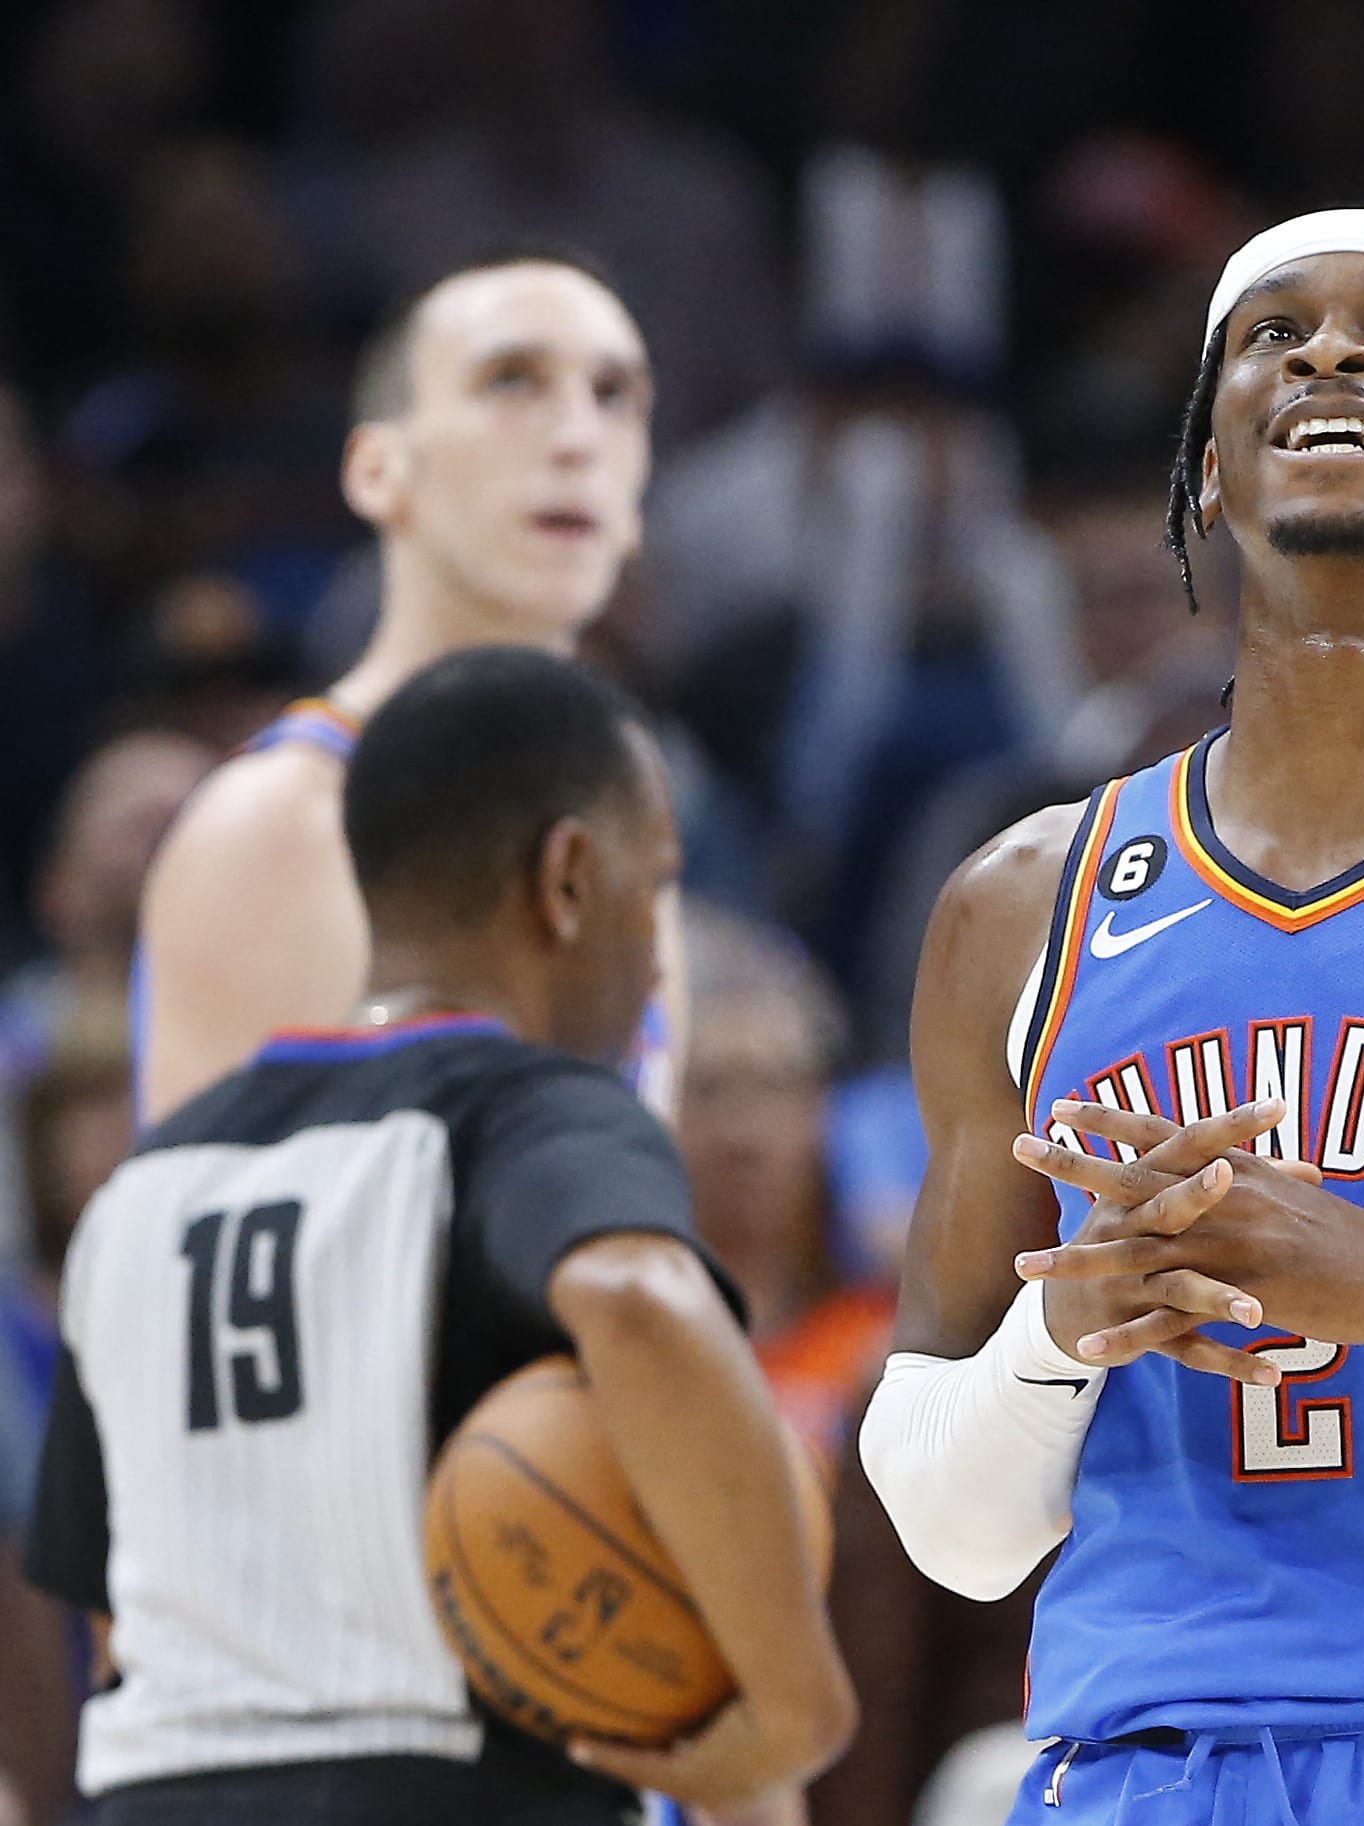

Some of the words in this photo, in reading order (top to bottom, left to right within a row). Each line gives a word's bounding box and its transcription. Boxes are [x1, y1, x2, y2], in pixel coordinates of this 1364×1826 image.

[1109, 841, 1155, 894] 6
[180, 1200, 305, 1430] 19
[1230, 1335, 1353, 1482] 2
